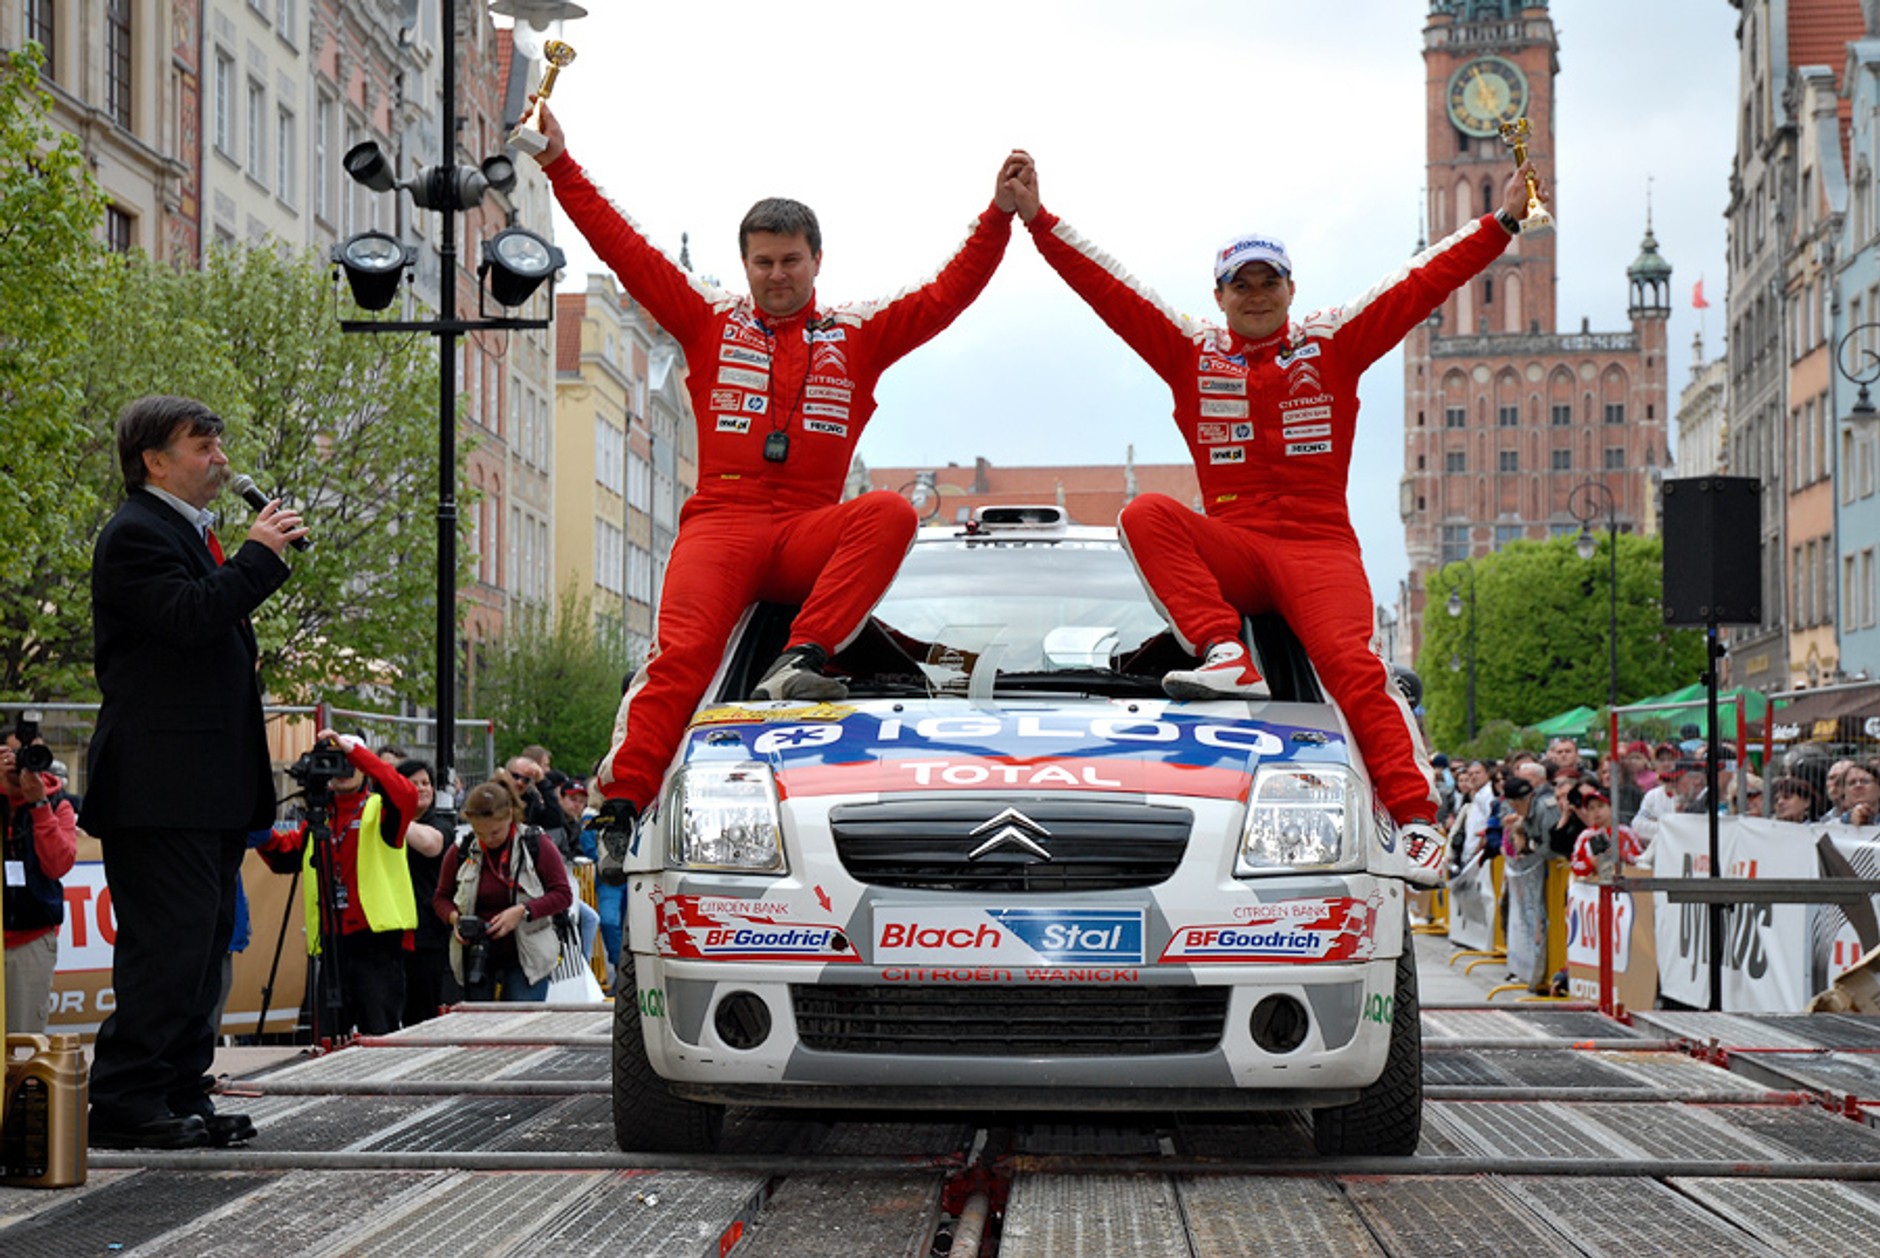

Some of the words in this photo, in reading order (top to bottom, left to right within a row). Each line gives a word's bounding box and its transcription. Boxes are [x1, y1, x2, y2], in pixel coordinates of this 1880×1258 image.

[901, 762, 1121, 788] TOTAL
[700, 899, 749, 914] CITROËN
[753, 902, 789, 914] BANK
[1233, 904, 1289, 919] CITROËN
[1293, 904, 1327, 918] BANK
[879, 923, 1001, 948] Blach
[1042, 924, 1122, 950] Stal
[1185, 930, 1320, 948] BFGoodrich
[881, 966, 1013, 982] CITROËN
[1025, 969, 1139, 982] WANICKI
